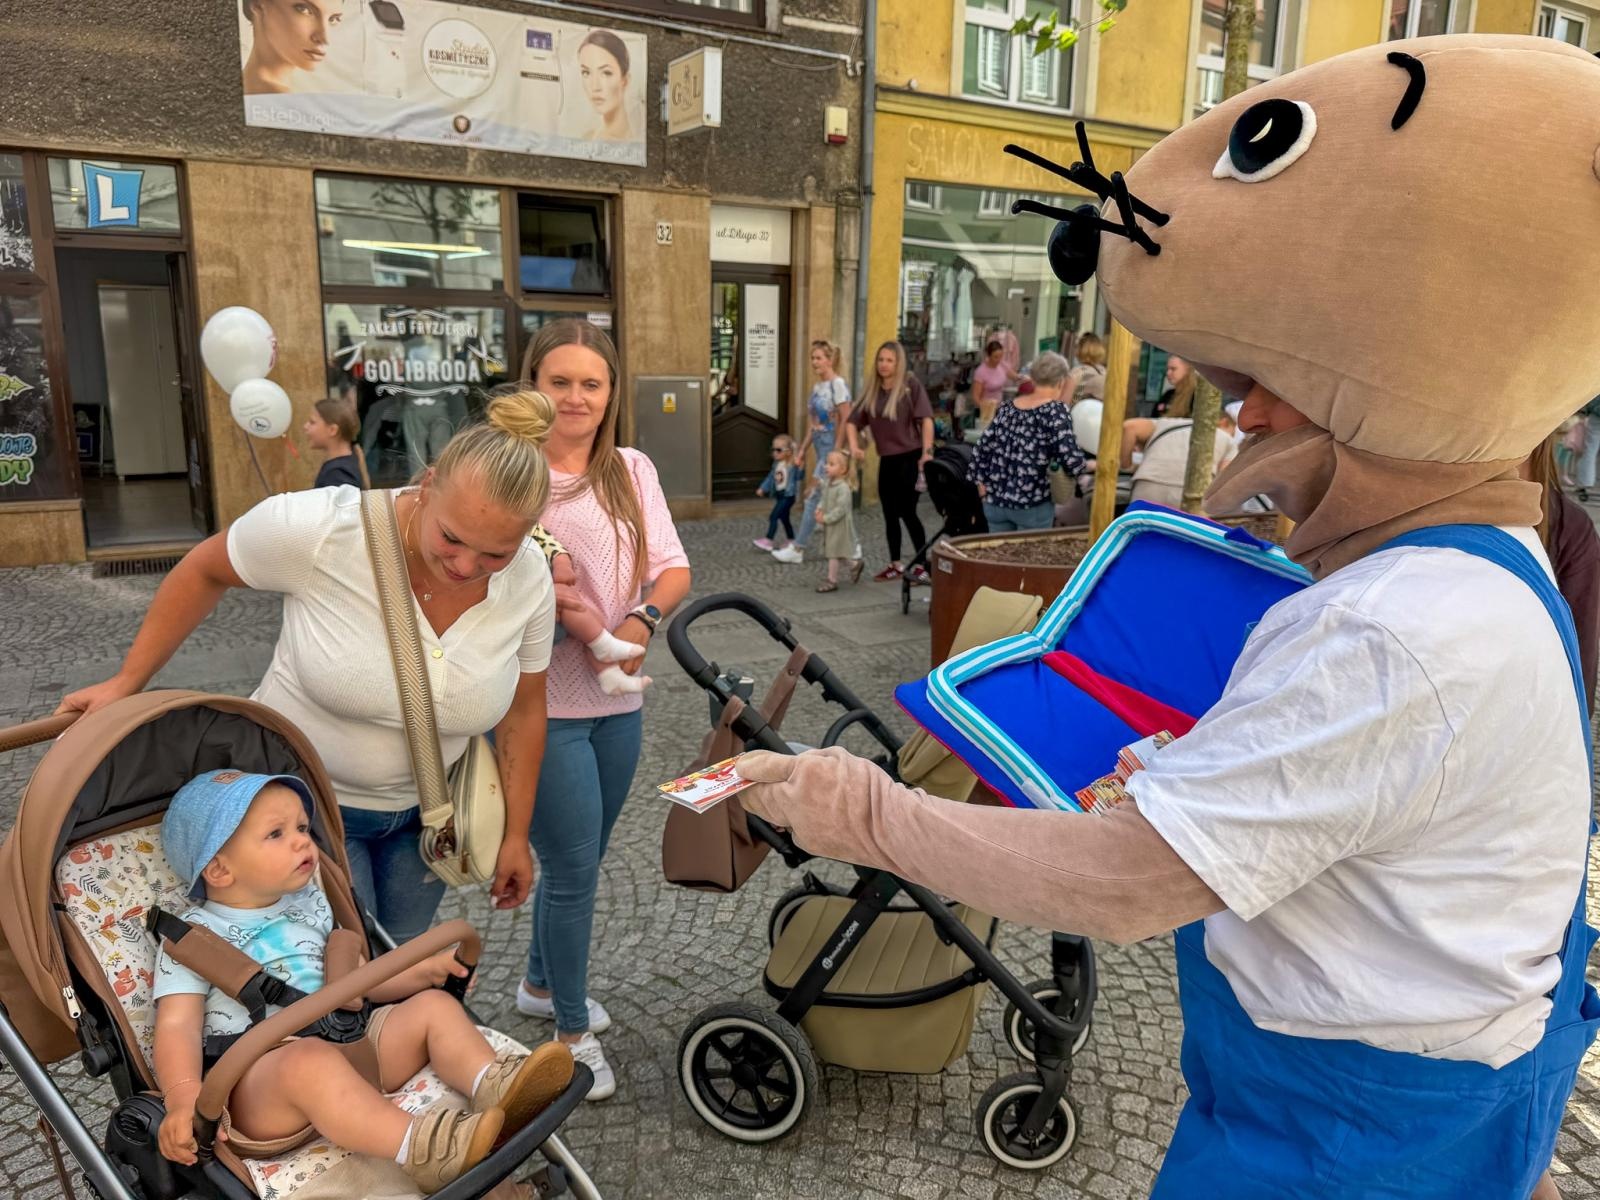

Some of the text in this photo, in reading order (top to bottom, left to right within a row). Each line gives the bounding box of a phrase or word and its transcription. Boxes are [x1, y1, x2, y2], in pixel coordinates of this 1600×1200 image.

[905, 121, 991, 179] SALON
[96, 173, 130, 221] L
[656, 223, 672, 242] 32
[360, 320, 478, 337] ZAKŁAD FRYZJERSKI
[364, 359, 481, 382] GOLIBRODA
